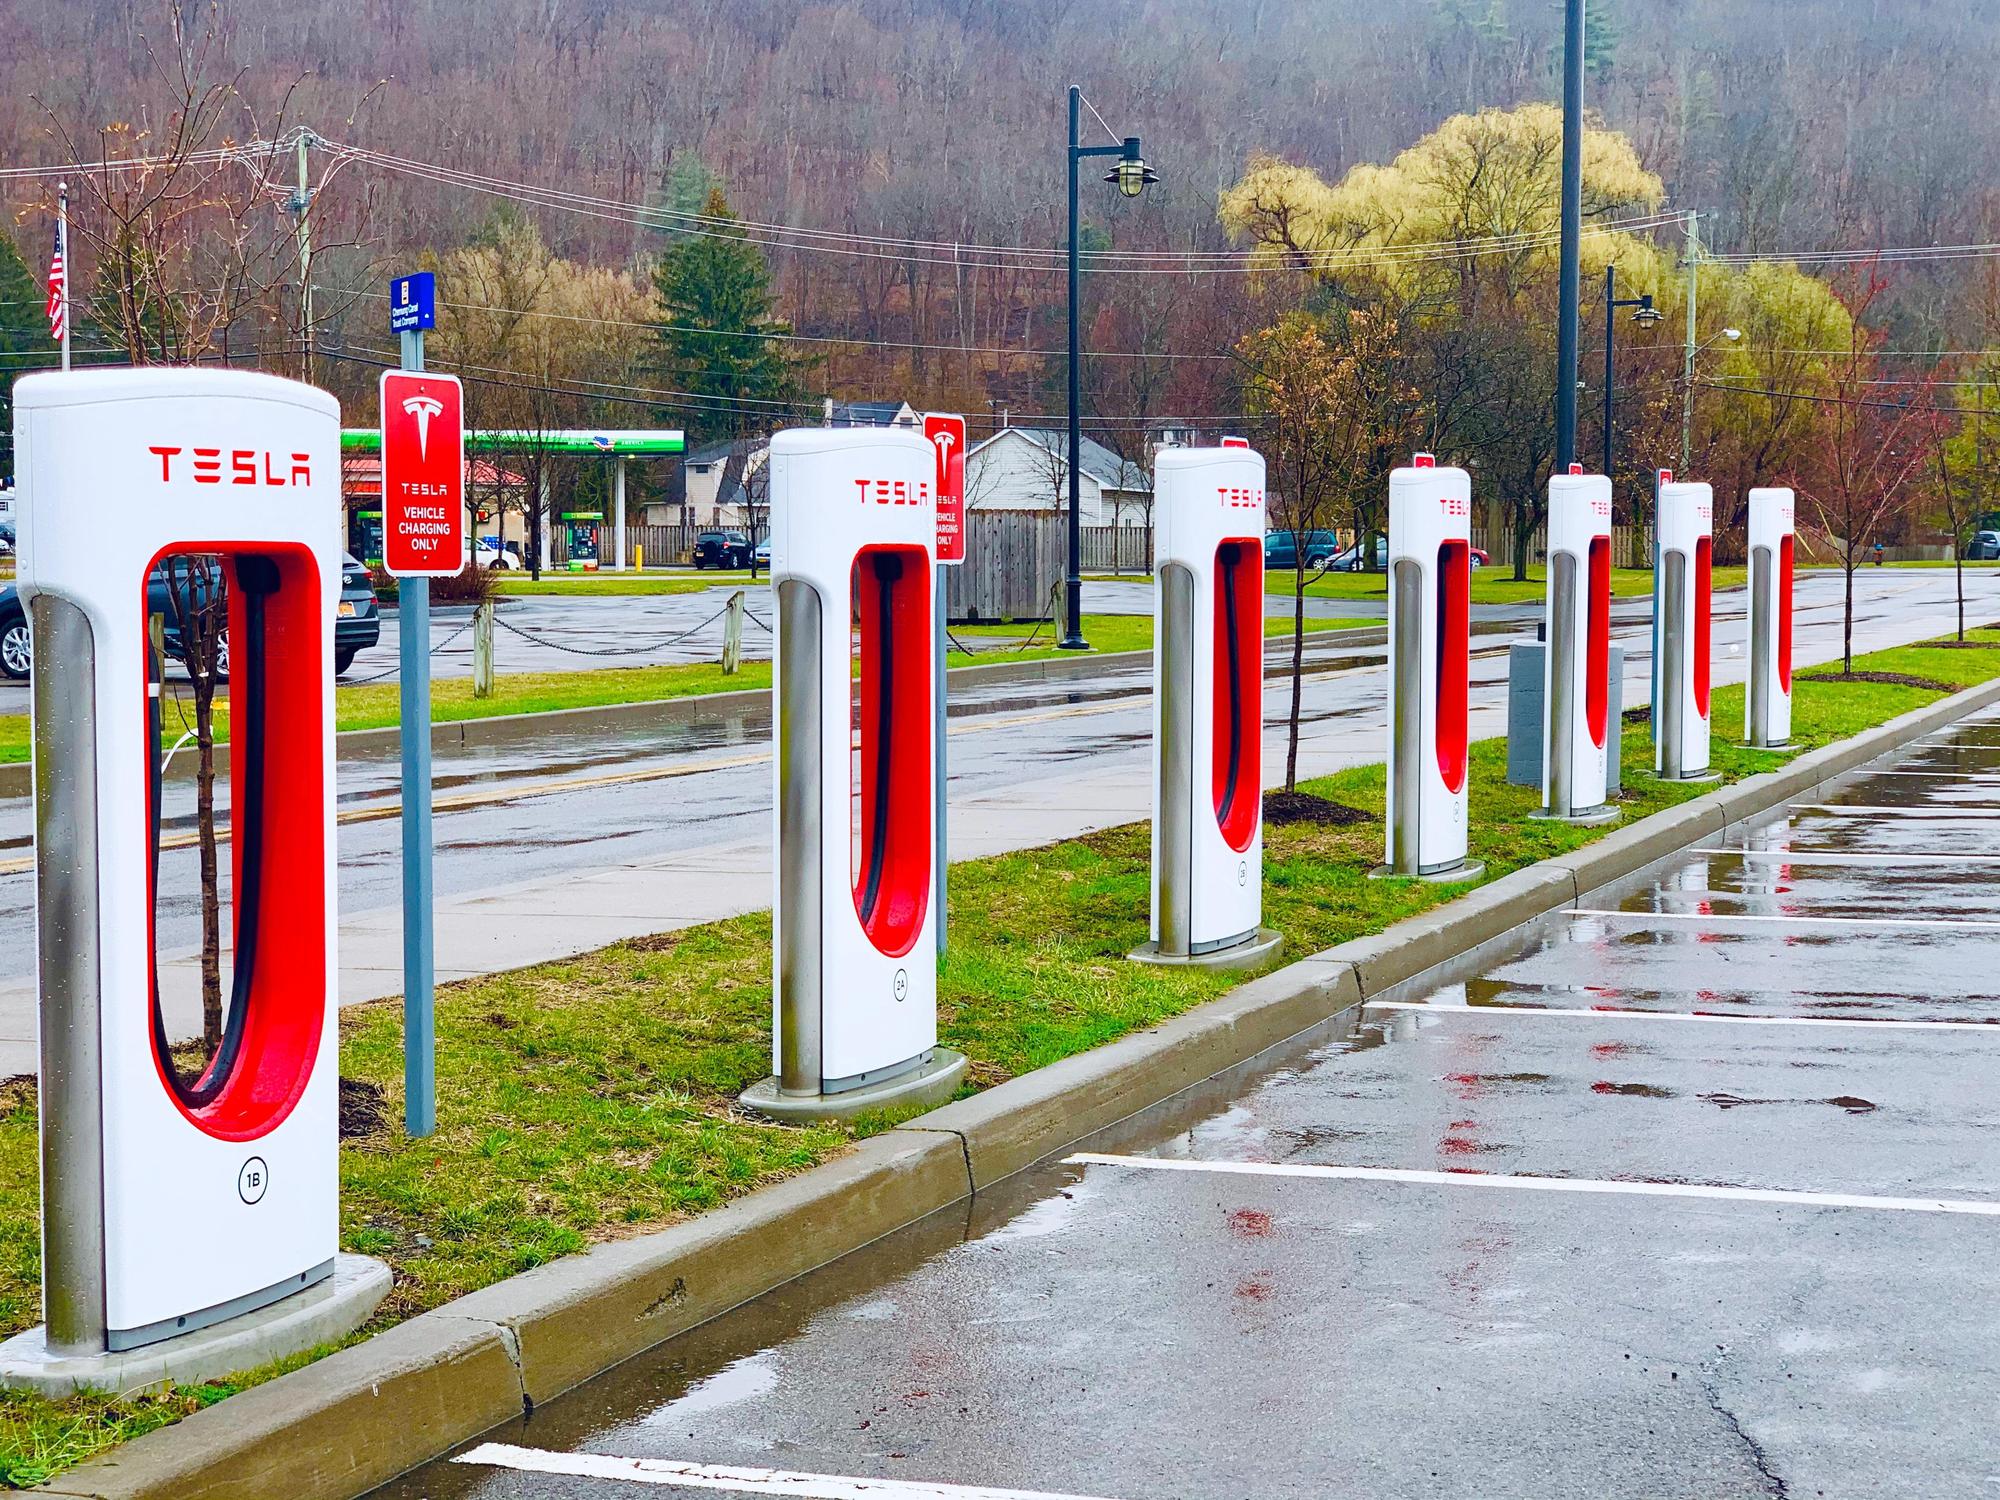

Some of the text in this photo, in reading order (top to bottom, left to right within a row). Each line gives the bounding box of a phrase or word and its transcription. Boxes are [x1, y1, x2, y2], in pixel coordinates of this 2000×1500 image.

[148, 446, 311, 488] TESLA
[401, 482, 447, 496] TESLA
[854, 479, 928, 507] TESLA
[938, 495, 957, 505] ESLA
[1217, 488, 1262, 508] TESLA
[404, 506, 445, 519] VEHICLE
[937, 512, 956, 522] EHICLE
[399, 522, 450, 535] CHARGING
[937, 524, 958, 534] HARGING
[411, 538, 438, 551] ONLY
[937, 535, 953, 545] ONLY
[247, 1172, 260, 1188] 1B
